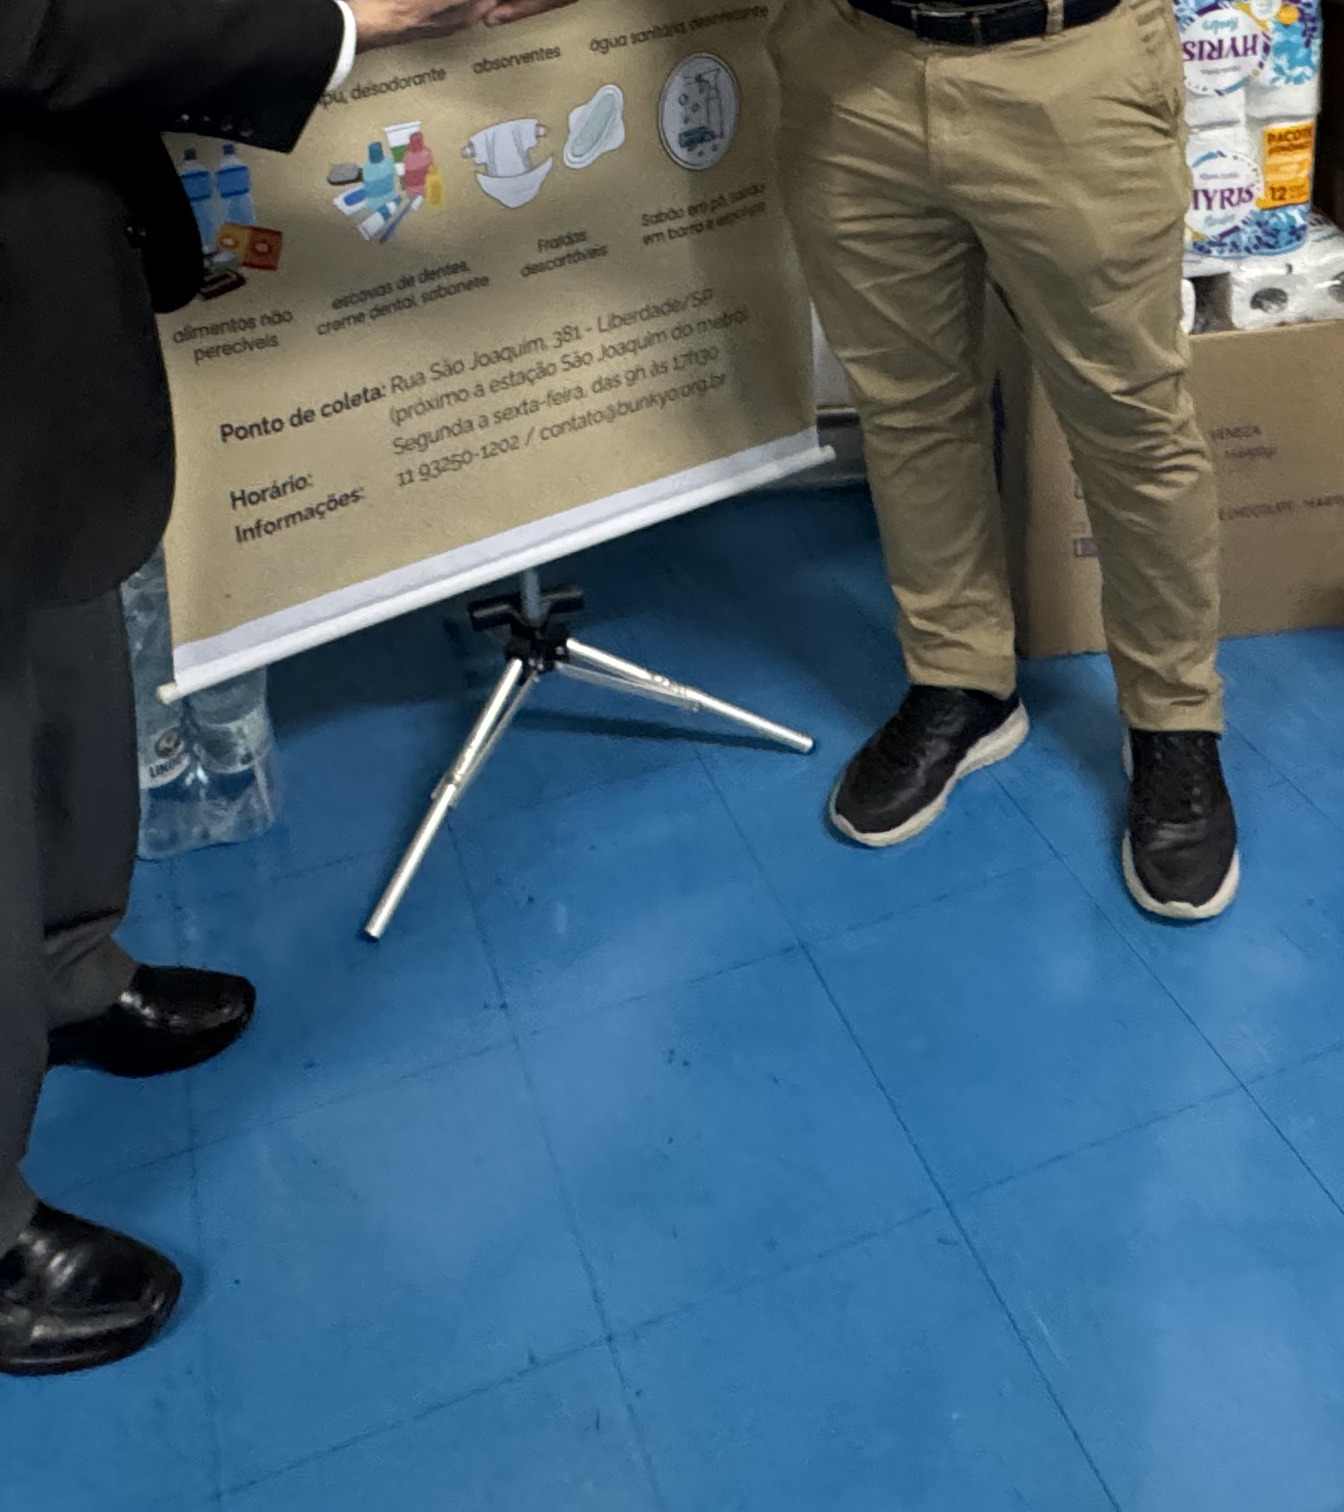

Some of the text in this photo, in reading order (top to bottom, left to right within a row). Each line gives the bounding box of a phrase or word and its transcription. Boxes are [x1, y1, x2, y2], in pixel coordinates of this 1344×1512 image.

[472, 46, 561, 75] absorventes
[1182, 33, 1258, 62] HYRIS
[351, 68, 447, 101] desodorante
[259, 307, 293, 327] não
[220, 417, 284, 444] Ponto
[289, 406, 316, 428] de
[320, 384, 387, 419] coleta:
[390, 371, 426, 395] Rua
[430, 357, 465, 382] São
[552, 325, 583, 350] 381
[390, 389, 470, 427] (próximo
[489, 362, 557, 395] estação
[560, 347, 593, 373] São
[597, 329, 668, 365] Joaquim
[230, 473, 314, 510] Horário:
[392, 417, 475, 455] Segunda
[477, 415, 490, 430] a
[590, 373, 623, 395] das
[235, 487, 366, 544] Informações:
[397, 468, 415, 487] 11
